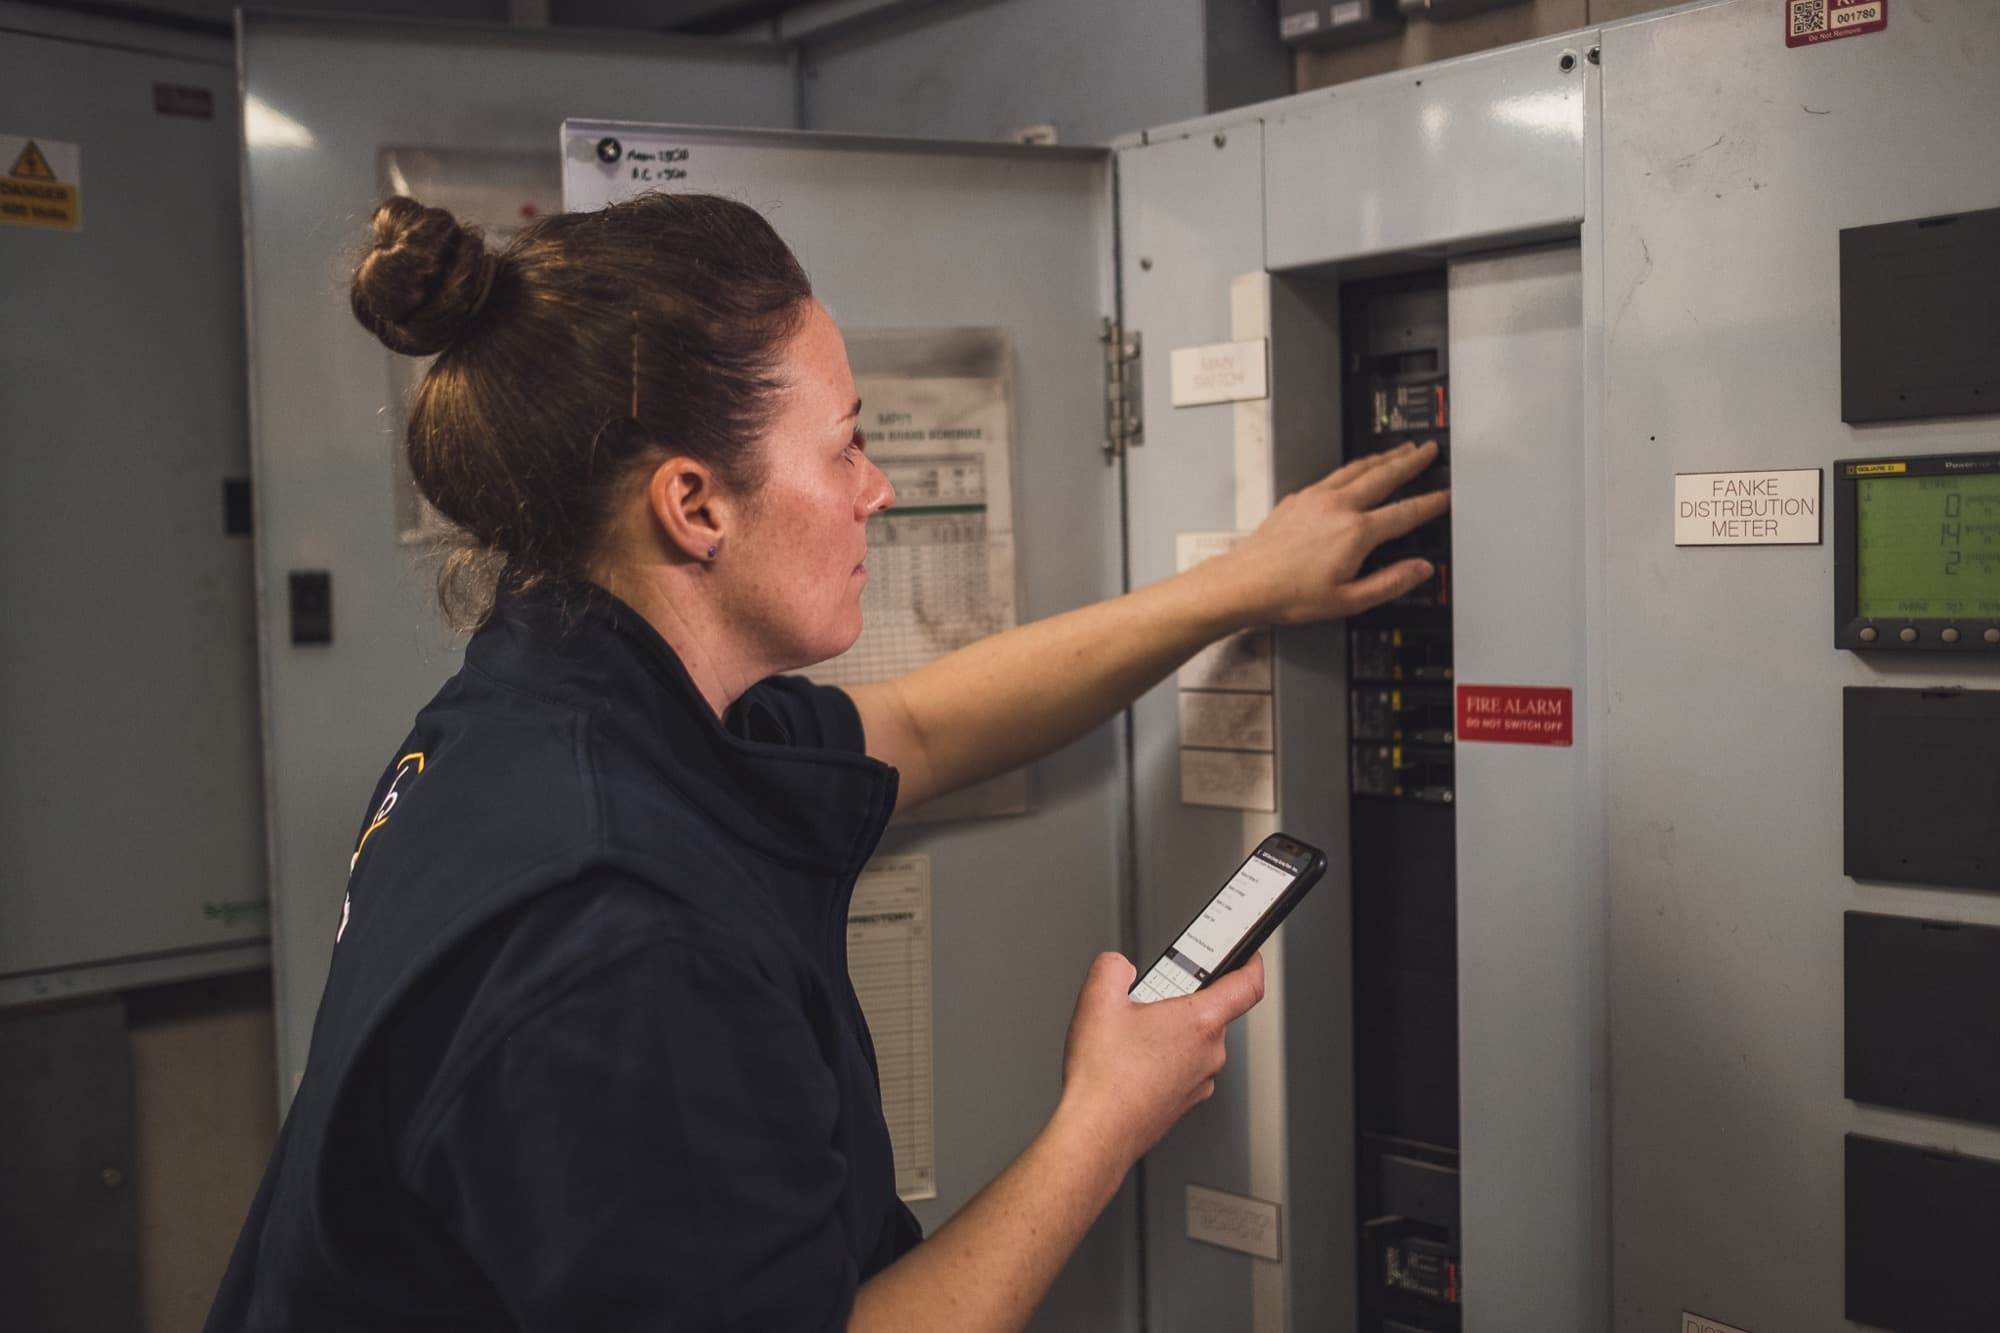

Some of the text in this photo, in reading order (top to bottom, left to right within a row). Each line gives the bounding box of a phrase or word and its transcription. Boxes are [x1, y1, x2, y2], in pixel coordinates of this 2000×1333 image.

[1837, 8, 1876, 24] 001780
[1712, 478, 1779, 497] FANKE
[1680, 497, 1815, 519] DISTRIBUTION
[1711, 519, 1779, 538] METER
[1466, 696, 1562, 715] FIRE ALARM
[1466, 717, 1562, 733] DO NOT SWITCH OFF
